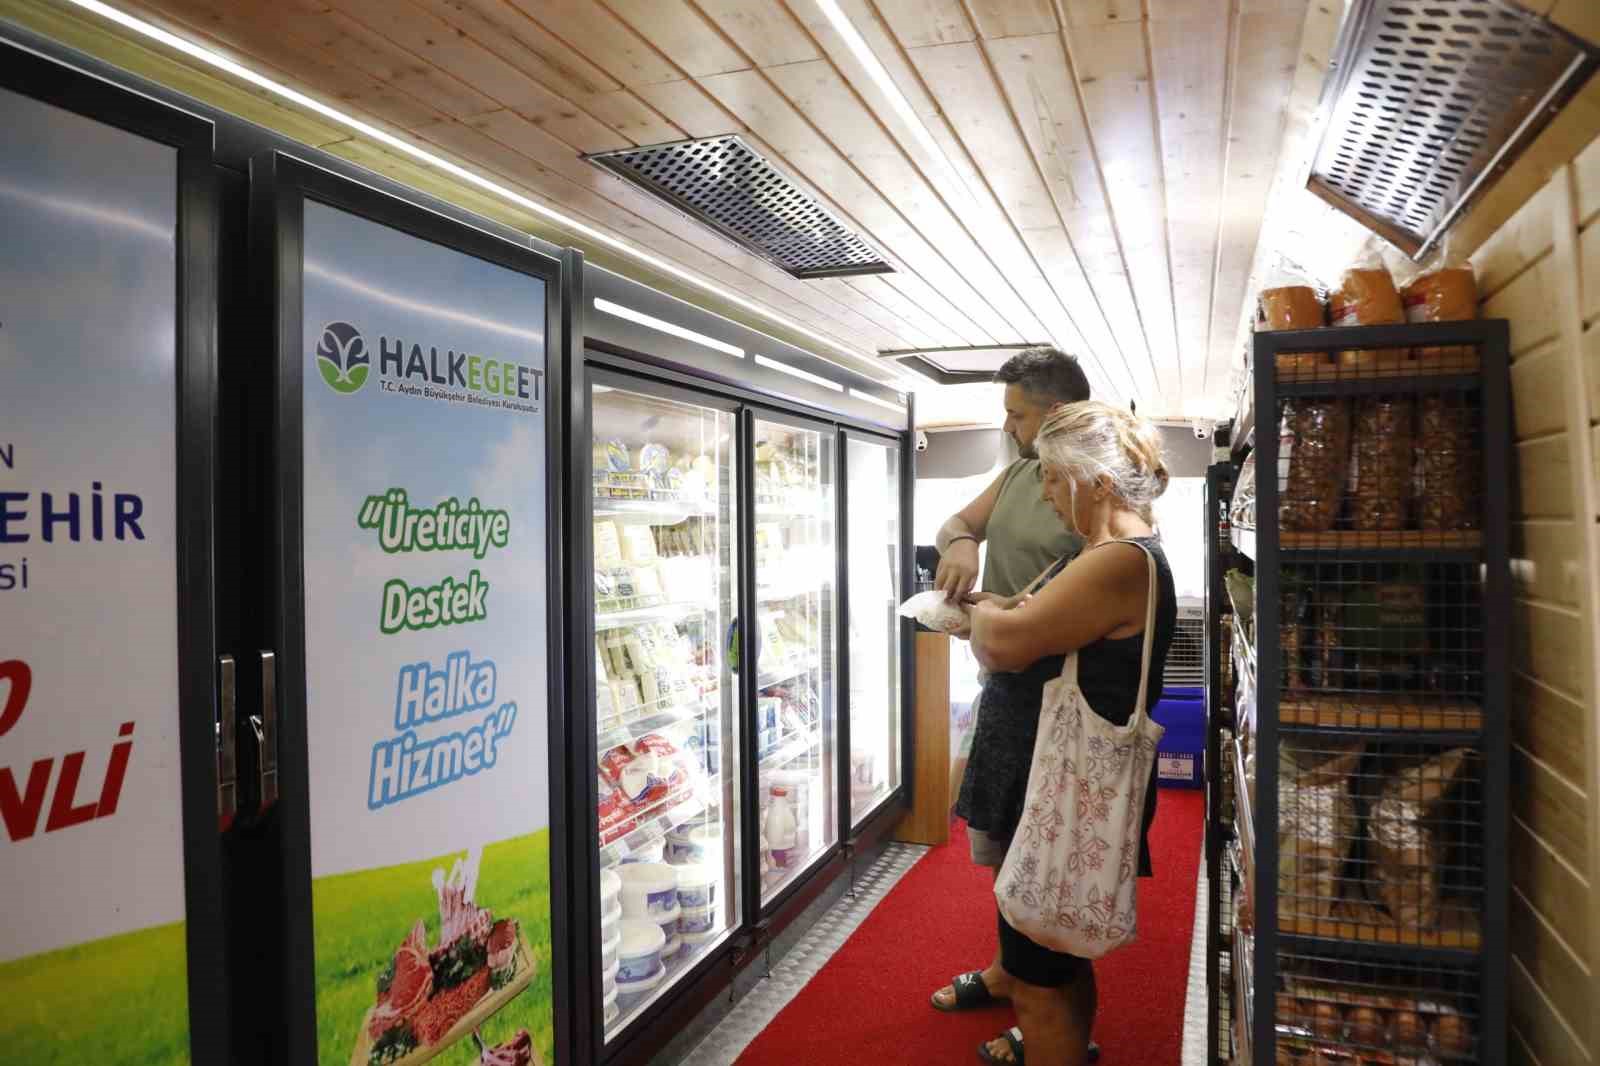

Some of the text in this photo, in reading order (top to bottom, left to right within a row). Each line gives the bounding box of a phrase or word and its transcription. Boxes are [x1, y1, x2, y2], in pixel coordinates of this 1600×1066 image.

[380, 336, 543, 401] HALKEGEET
[380, 569, 489, 634] Destek
[394, 650, 496, 730] Halka
